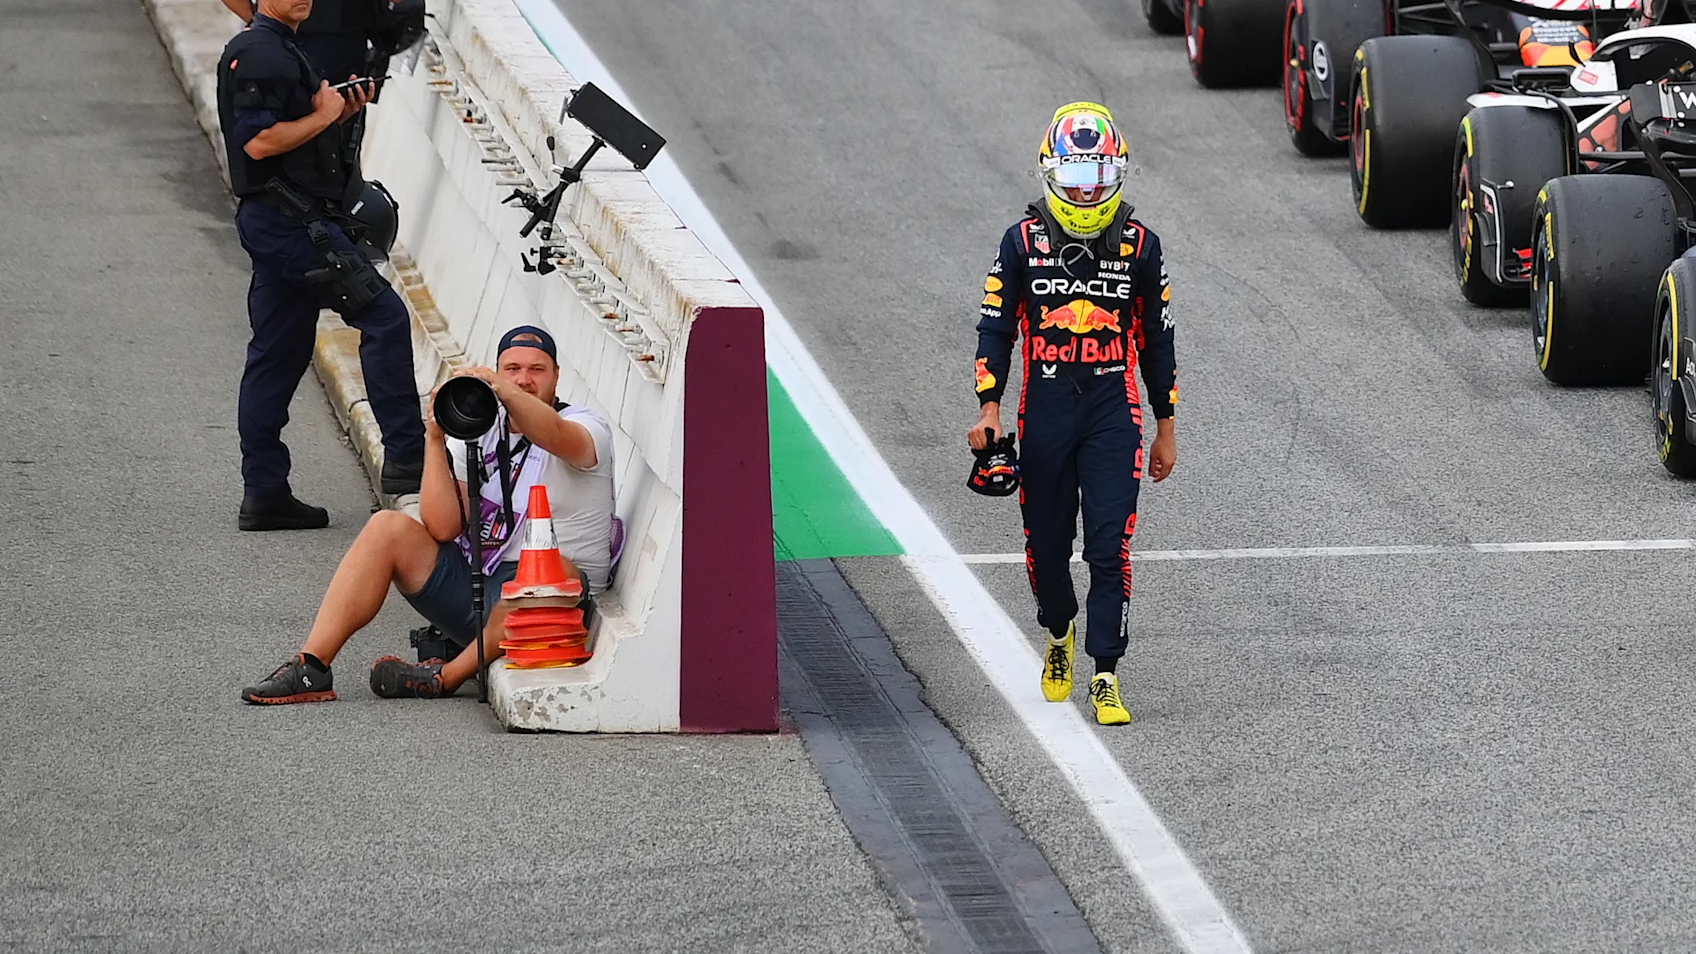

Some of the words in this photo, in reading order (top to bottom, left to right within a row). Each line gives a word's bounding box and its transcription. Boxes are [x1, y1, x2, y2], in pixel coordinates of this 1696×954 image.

[1061, 154, 1112, 164] ORACLE
[1028, 257, 1055, 267] Mobil
[1099, 259, 1131, 271] BYBIT
[1097, 271, 1132, 282] HONDA
[1031, 278, 1132, 300] ORACLE
[1031, 335, 1077, 363] Red
[1080, 336, 1124, 363] Bull
